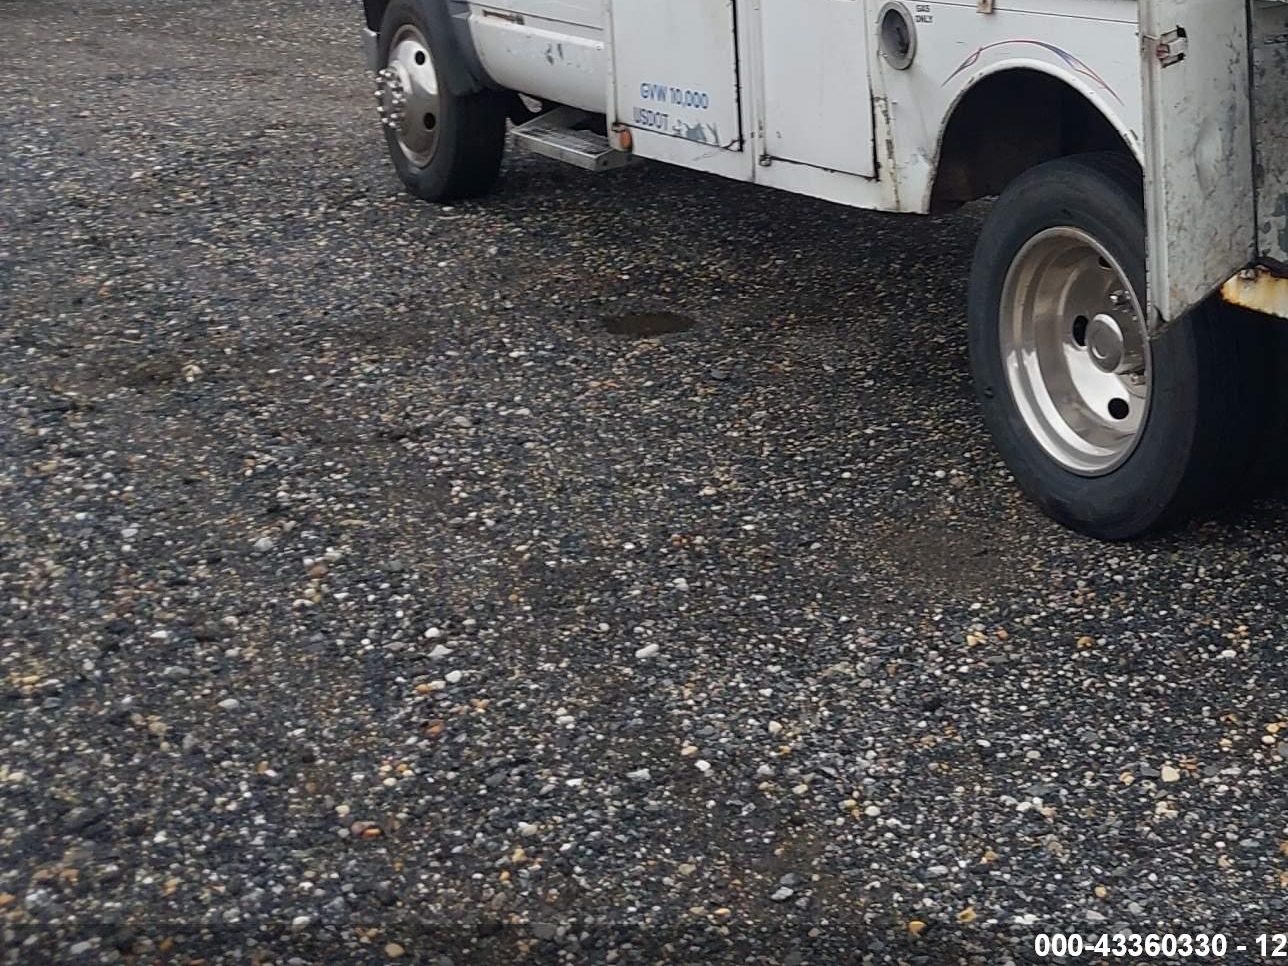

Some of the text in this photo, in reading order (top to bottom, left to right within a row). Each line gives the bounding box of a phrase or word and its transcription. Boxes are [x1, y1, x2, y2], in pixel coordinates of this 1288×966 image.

[640, 82, 709, 110] GVW 10,000
[633, 106, 668, 131] USDOT
